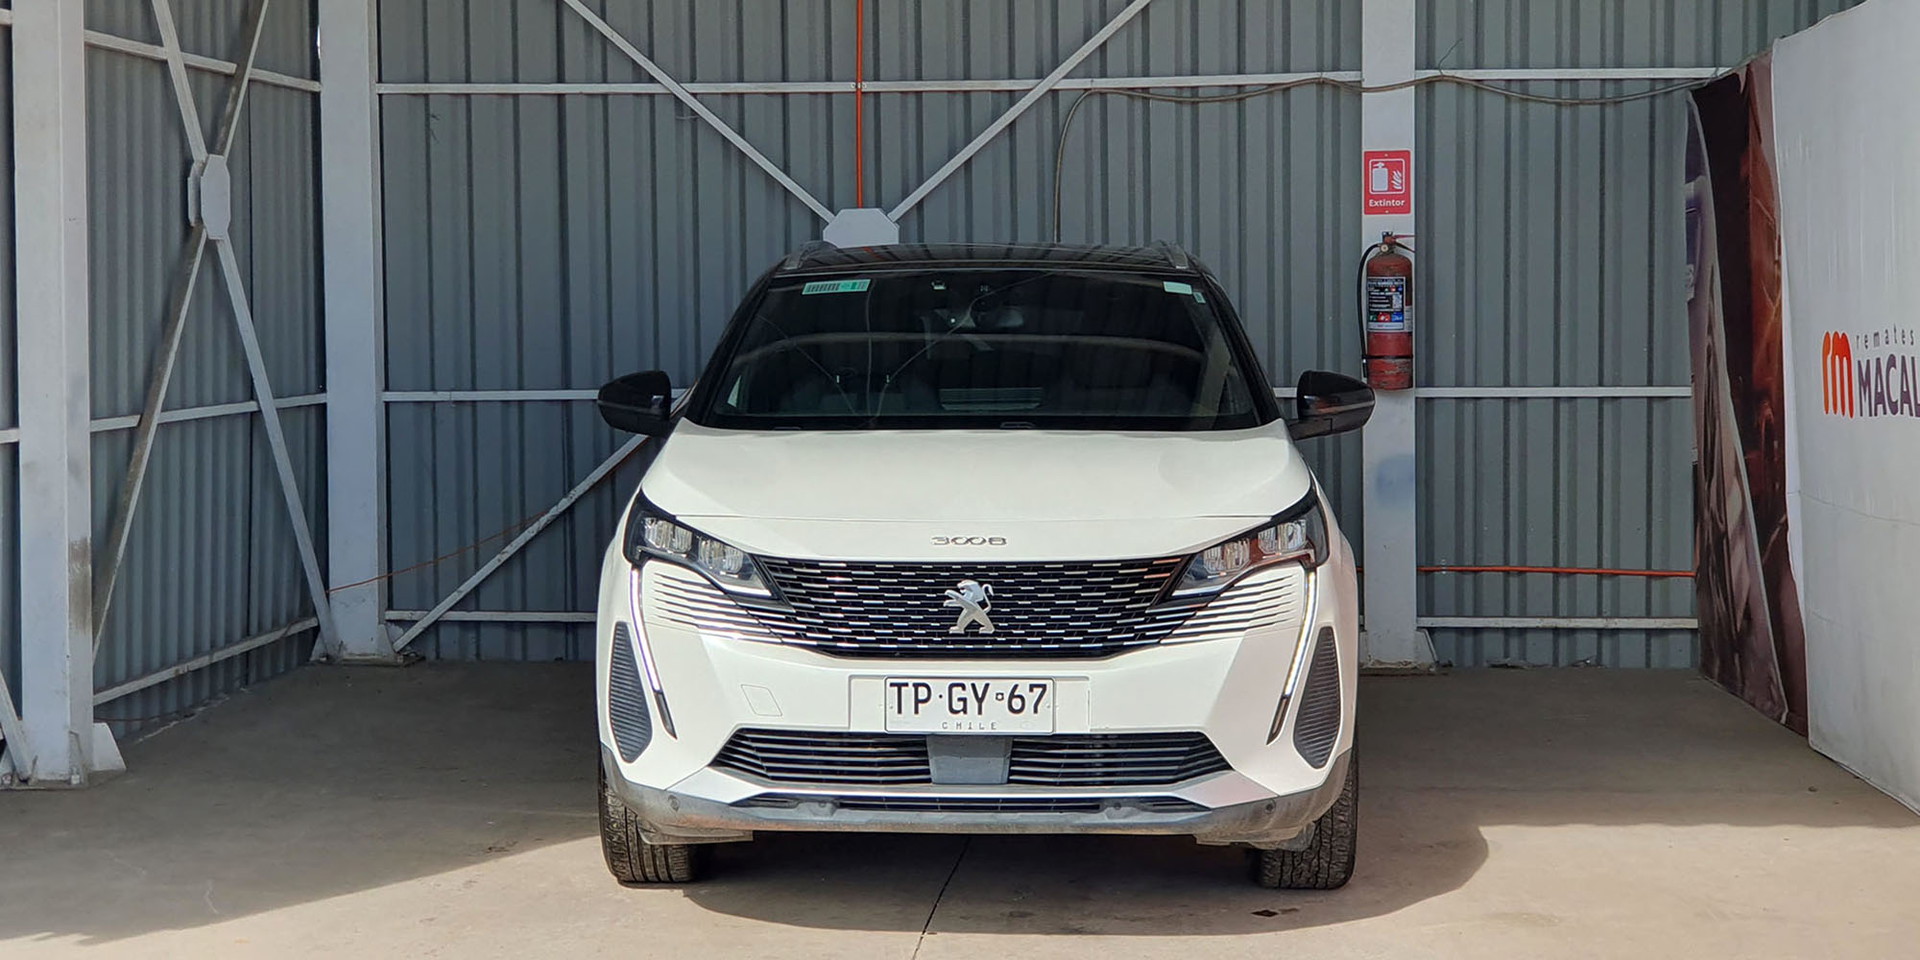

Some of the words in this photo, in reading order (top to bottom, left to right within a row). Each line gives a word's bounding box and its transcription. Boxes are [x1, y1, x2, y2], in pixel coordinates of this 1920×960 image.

[1368, 198, 1405, 208] Extintor
[1856, 324, 1914, 349] remates
[1857, 353, 1920, 418] MACAL
[931, 536, 1007, 546] 3008
[941, 721, 997, 731] CHILE
